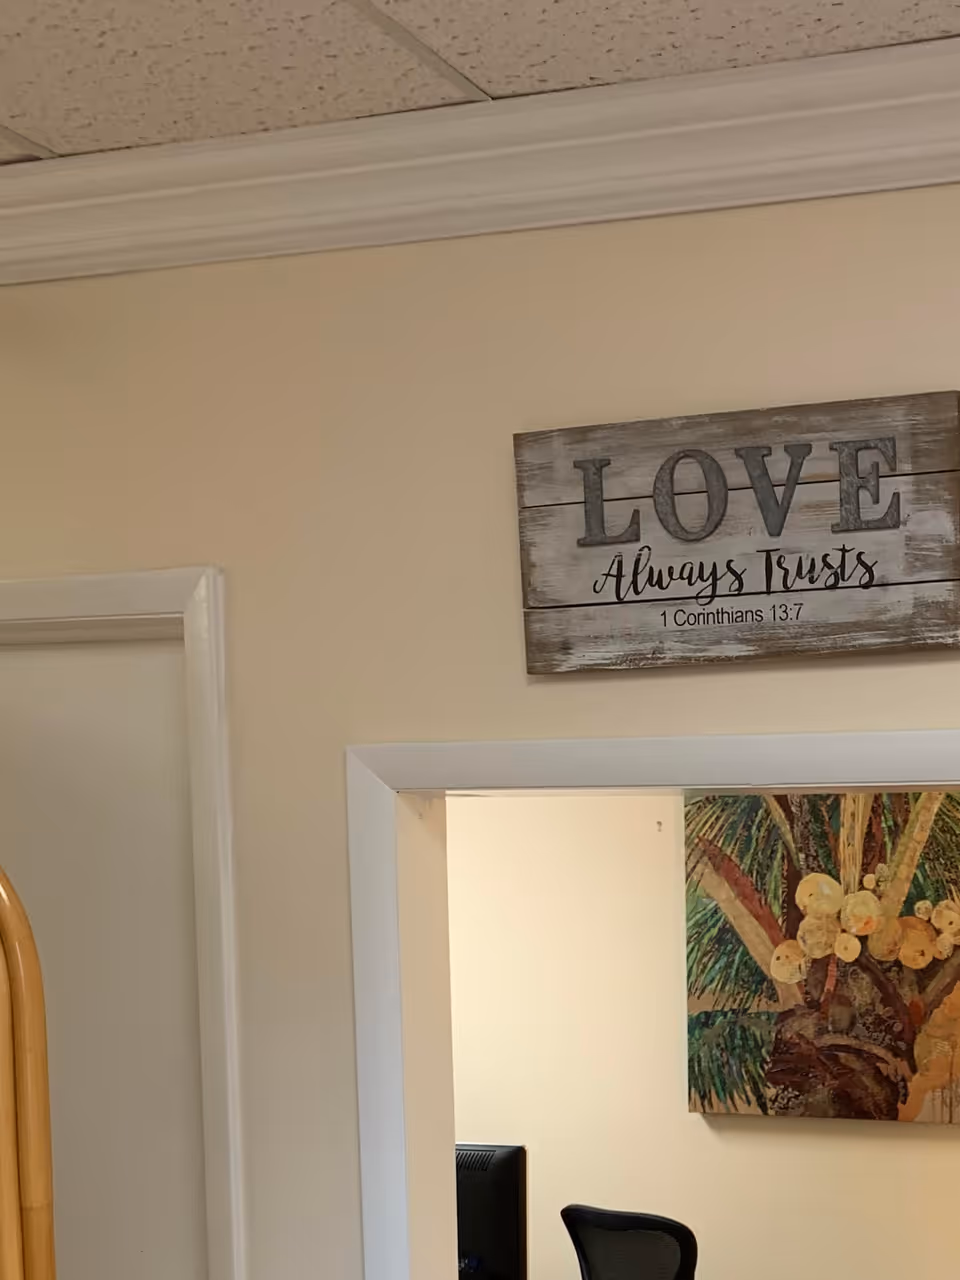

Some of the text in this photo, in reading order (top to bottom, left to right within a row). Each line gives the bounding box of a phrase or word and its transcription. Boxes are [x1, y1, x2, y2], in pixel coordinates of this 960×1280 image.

[573, 437, 900, 548] LOVE
[593, 544, 878, 606] Always Trusts
[660, 602, 804, 627] 1 Corinthians 13:7
